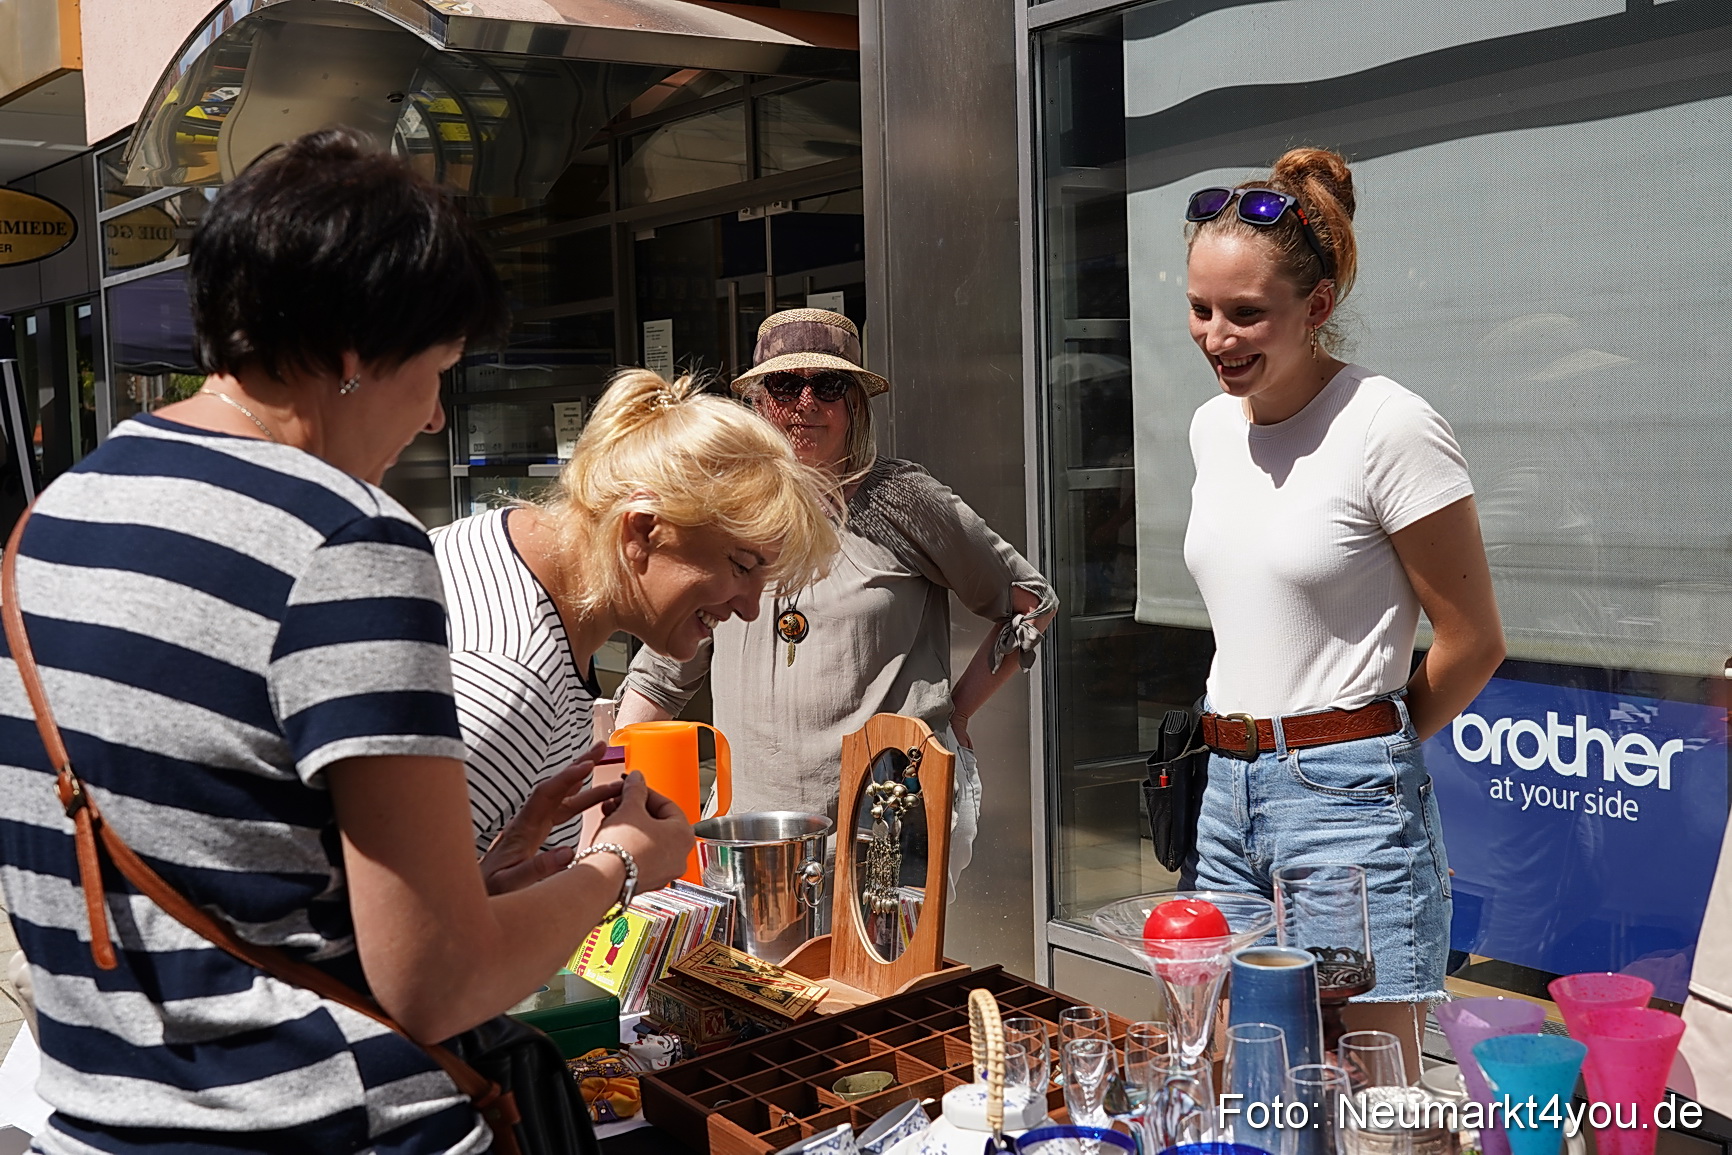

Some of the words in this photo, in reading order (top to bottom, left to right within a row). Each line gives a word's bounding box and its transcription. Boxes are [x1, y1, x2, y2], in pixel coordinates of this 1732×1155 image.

[0, 220, 68, 236] MIEDE
[1452, 711, 1684, 790] brother
[1489, 776, 1514, 802] at
[1520, 782, 1580, 811] your
[1584, 787, 1639, 822] side
